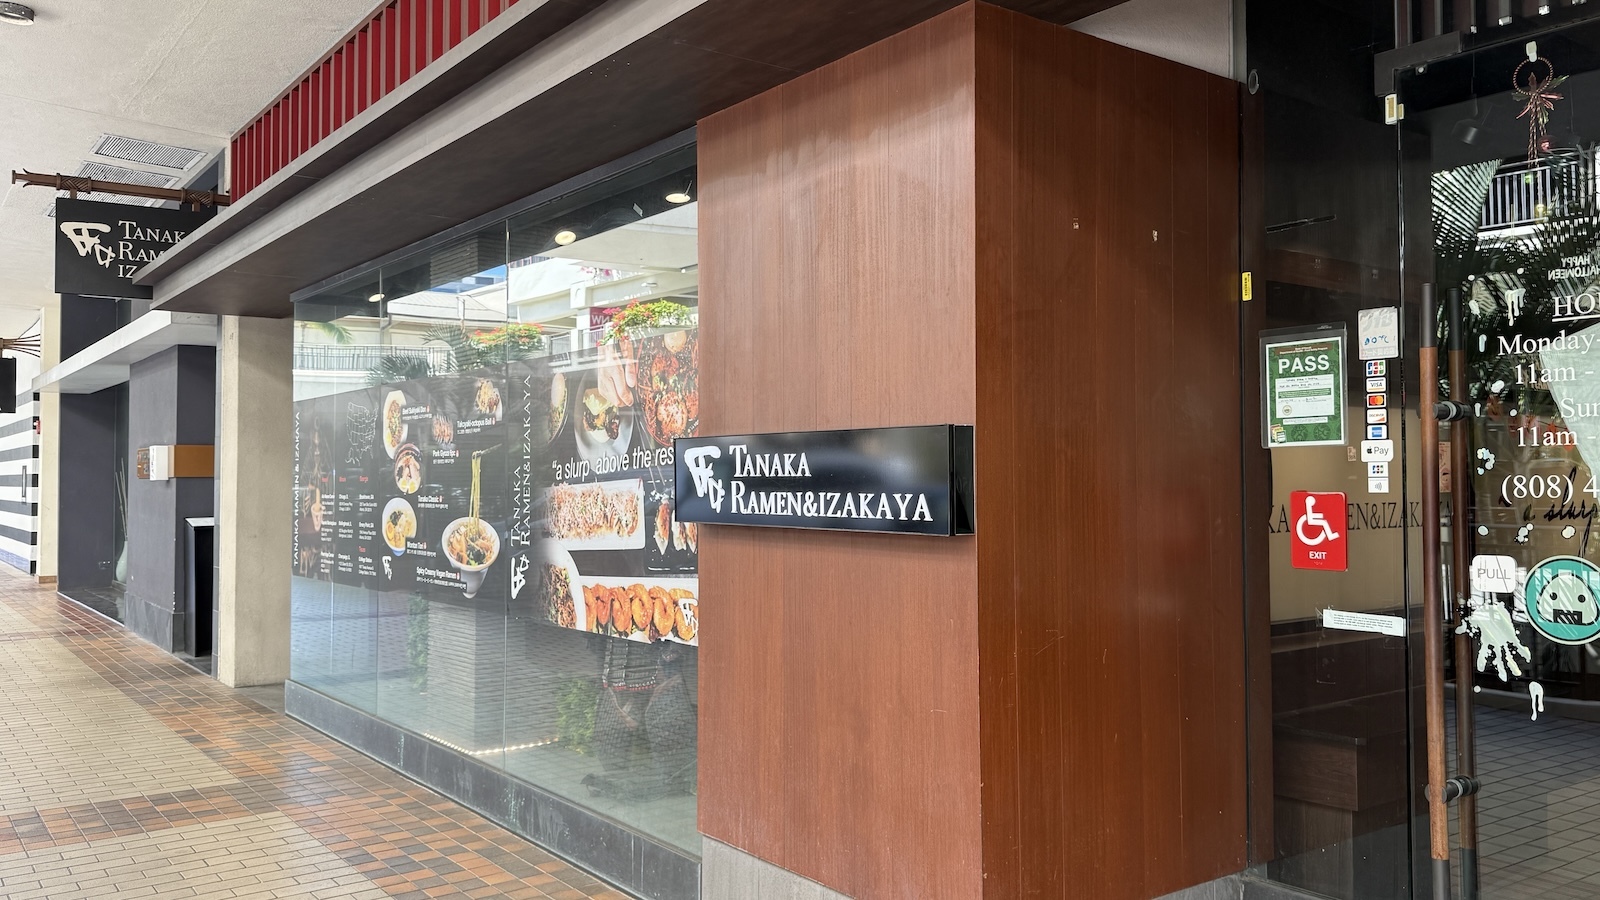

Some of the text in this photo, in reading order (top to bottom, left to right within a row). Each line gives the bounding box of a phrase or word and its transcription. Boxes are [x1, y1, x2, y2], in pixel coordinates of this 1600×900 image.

[118, 220, 186, 243] TANAK
[118, 241, 165, 262] RAM
[117, 264, 138, 279] IZ
[1552, 293, 1600, 317] HO
[1278, 354, 1330, 374] PASS
[1367, 361, 1384, 375] JCB
[1515, 363, 1577, 385] 11am
[1517, 426, 1579, 447] 11am
[520, 374, 531, 546] RAMEN&IZAKAYA
[729, 444, 812, 478] TANAKA
[1373, 446, 1389, 456] Pay
[564, 457, 590, 482] slurp
[595, 451, 629, 475] above
[632, 445, 652, 470] the
[654, 446, 674, 467] res
[1501, 474, 1600, 505] (808) 4
[511, 466, 521, 547] TANAKA
[730, 480, 934, 522] RAMEN&IZAKAYA
[1309, 551, 1327, 560] EXIT
[1477, 568, 1512, 580] PULL
